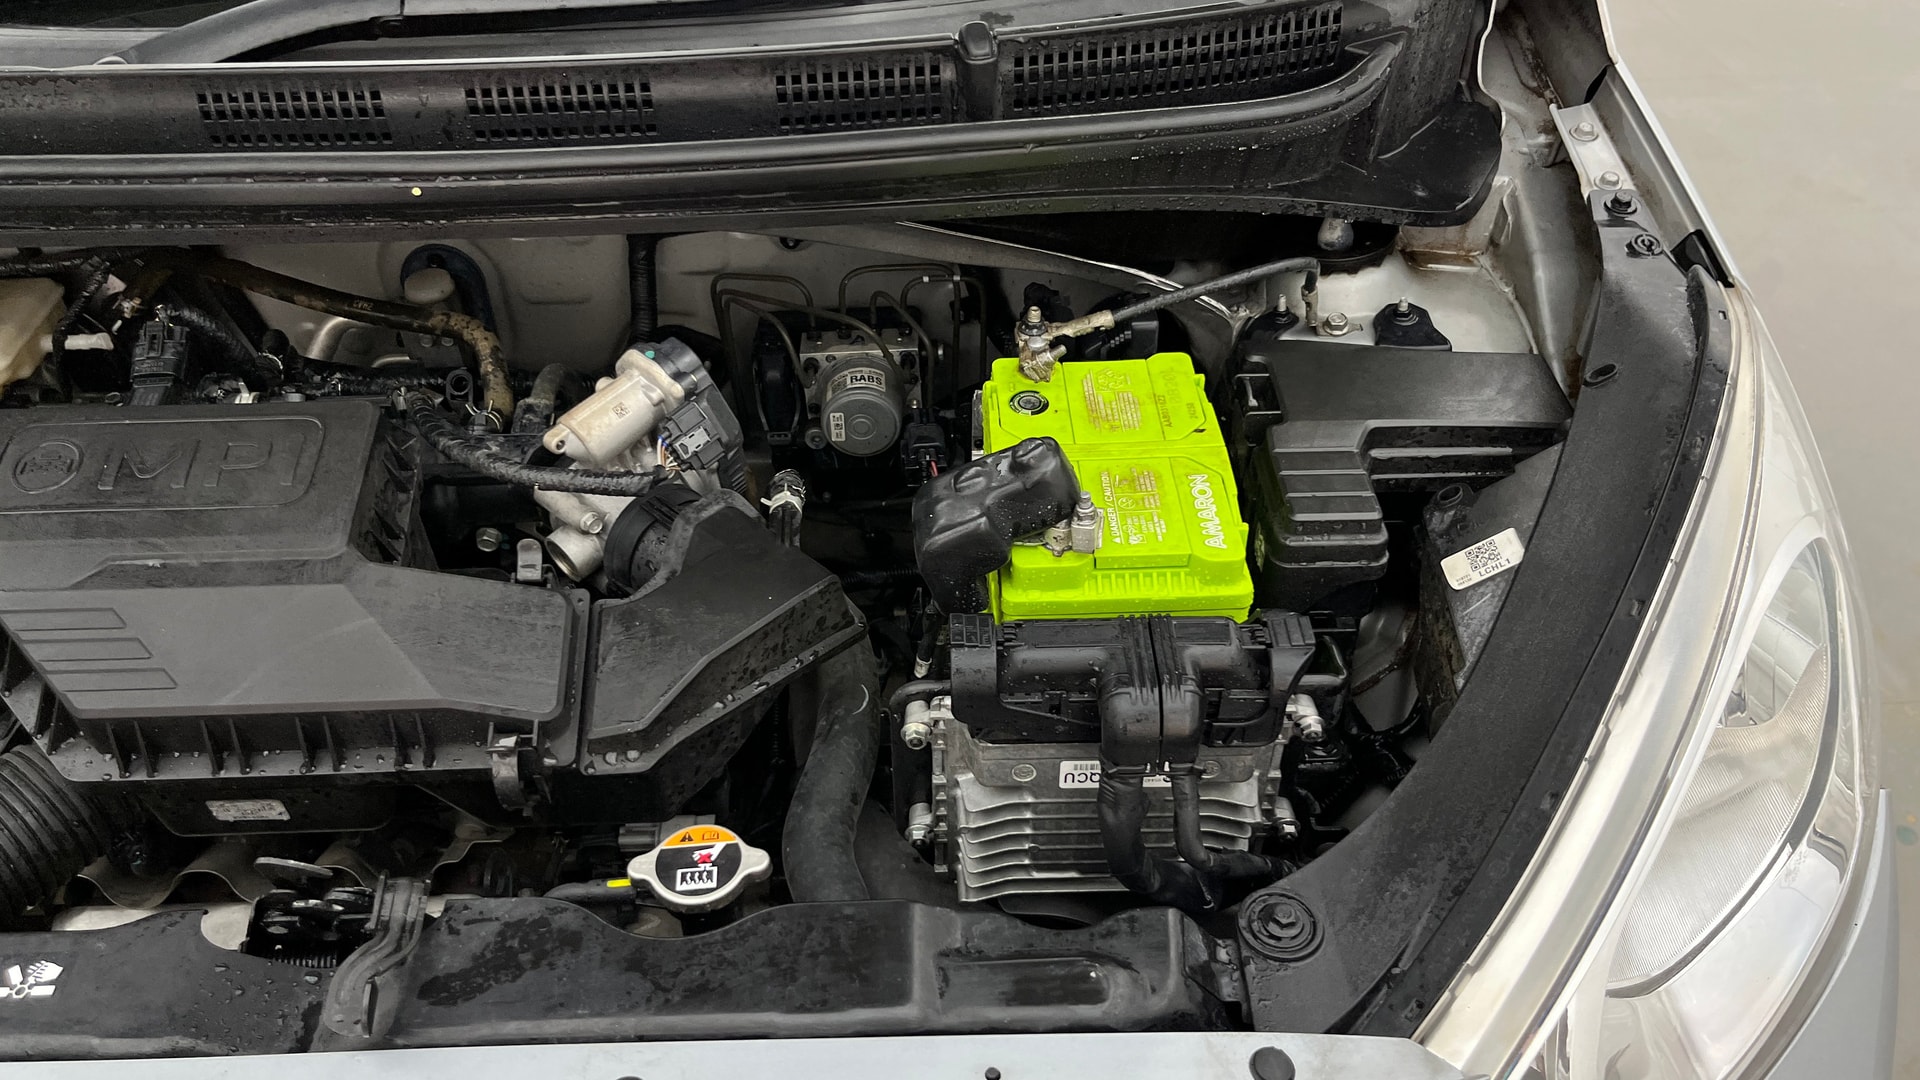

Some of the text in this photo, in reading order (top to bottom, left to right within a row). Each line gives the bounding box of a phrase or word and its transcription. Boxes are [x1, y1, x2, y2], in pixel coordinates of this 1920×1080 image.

[850, 374, 882, 386] RABS
[97, 431, 305, 491] MPI
[1100, 471, 1113, 502] CAUTION
[1107, 507, 1120, 536] DANGER
[1187, 473, 1228, 549] AMARON
[1478, 558, 1511, 577] LCHL1
